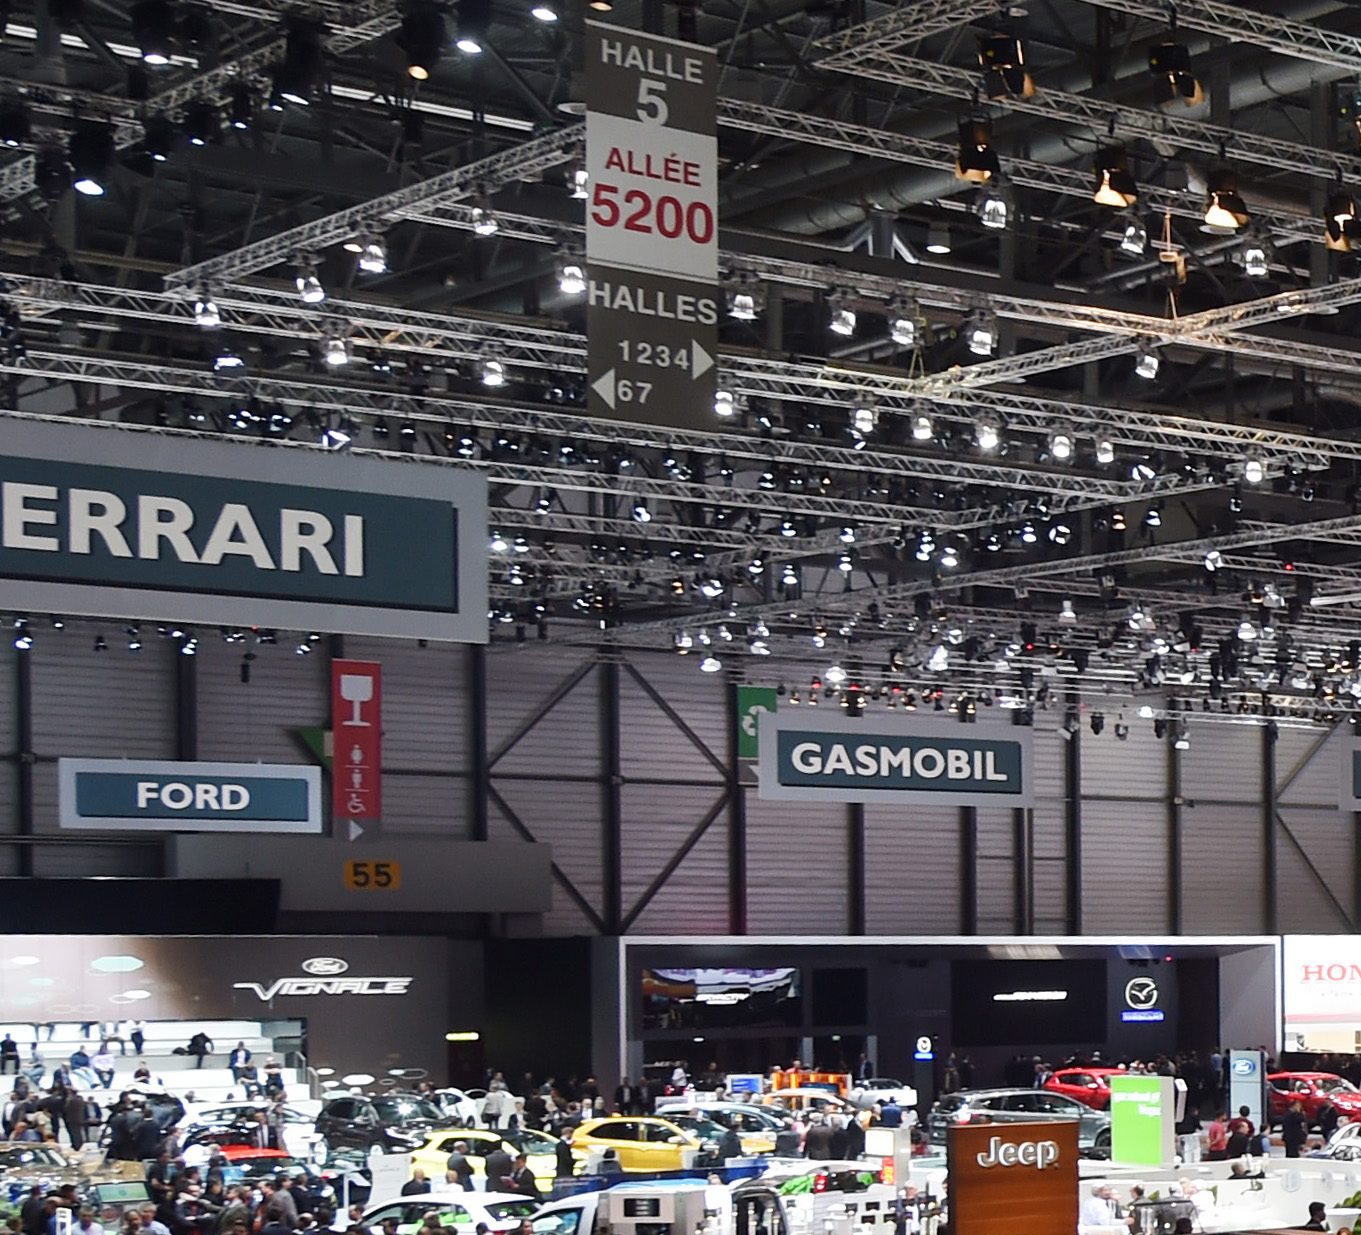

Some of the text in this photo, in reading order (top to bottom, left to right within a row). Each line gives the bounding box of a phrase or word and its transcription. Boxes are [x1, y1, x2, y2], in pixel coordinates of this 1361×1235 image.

[601, 38, 704, 84] HALLE
[636, 78, 669, 127] 5
[605, 147, 702, 187] ALLÉE
[591, 183, 714, 244] 5200
[588, 280, 718, 325] HALLES
[1, 480, 364, 577] ERRARI
[791, 742, 1008, 782] GASMOBIL
[137, 782, 250, 811] FORD
[352, 863, 391, 888] 55
[977, 1136, 1059, 1169] Jeep
